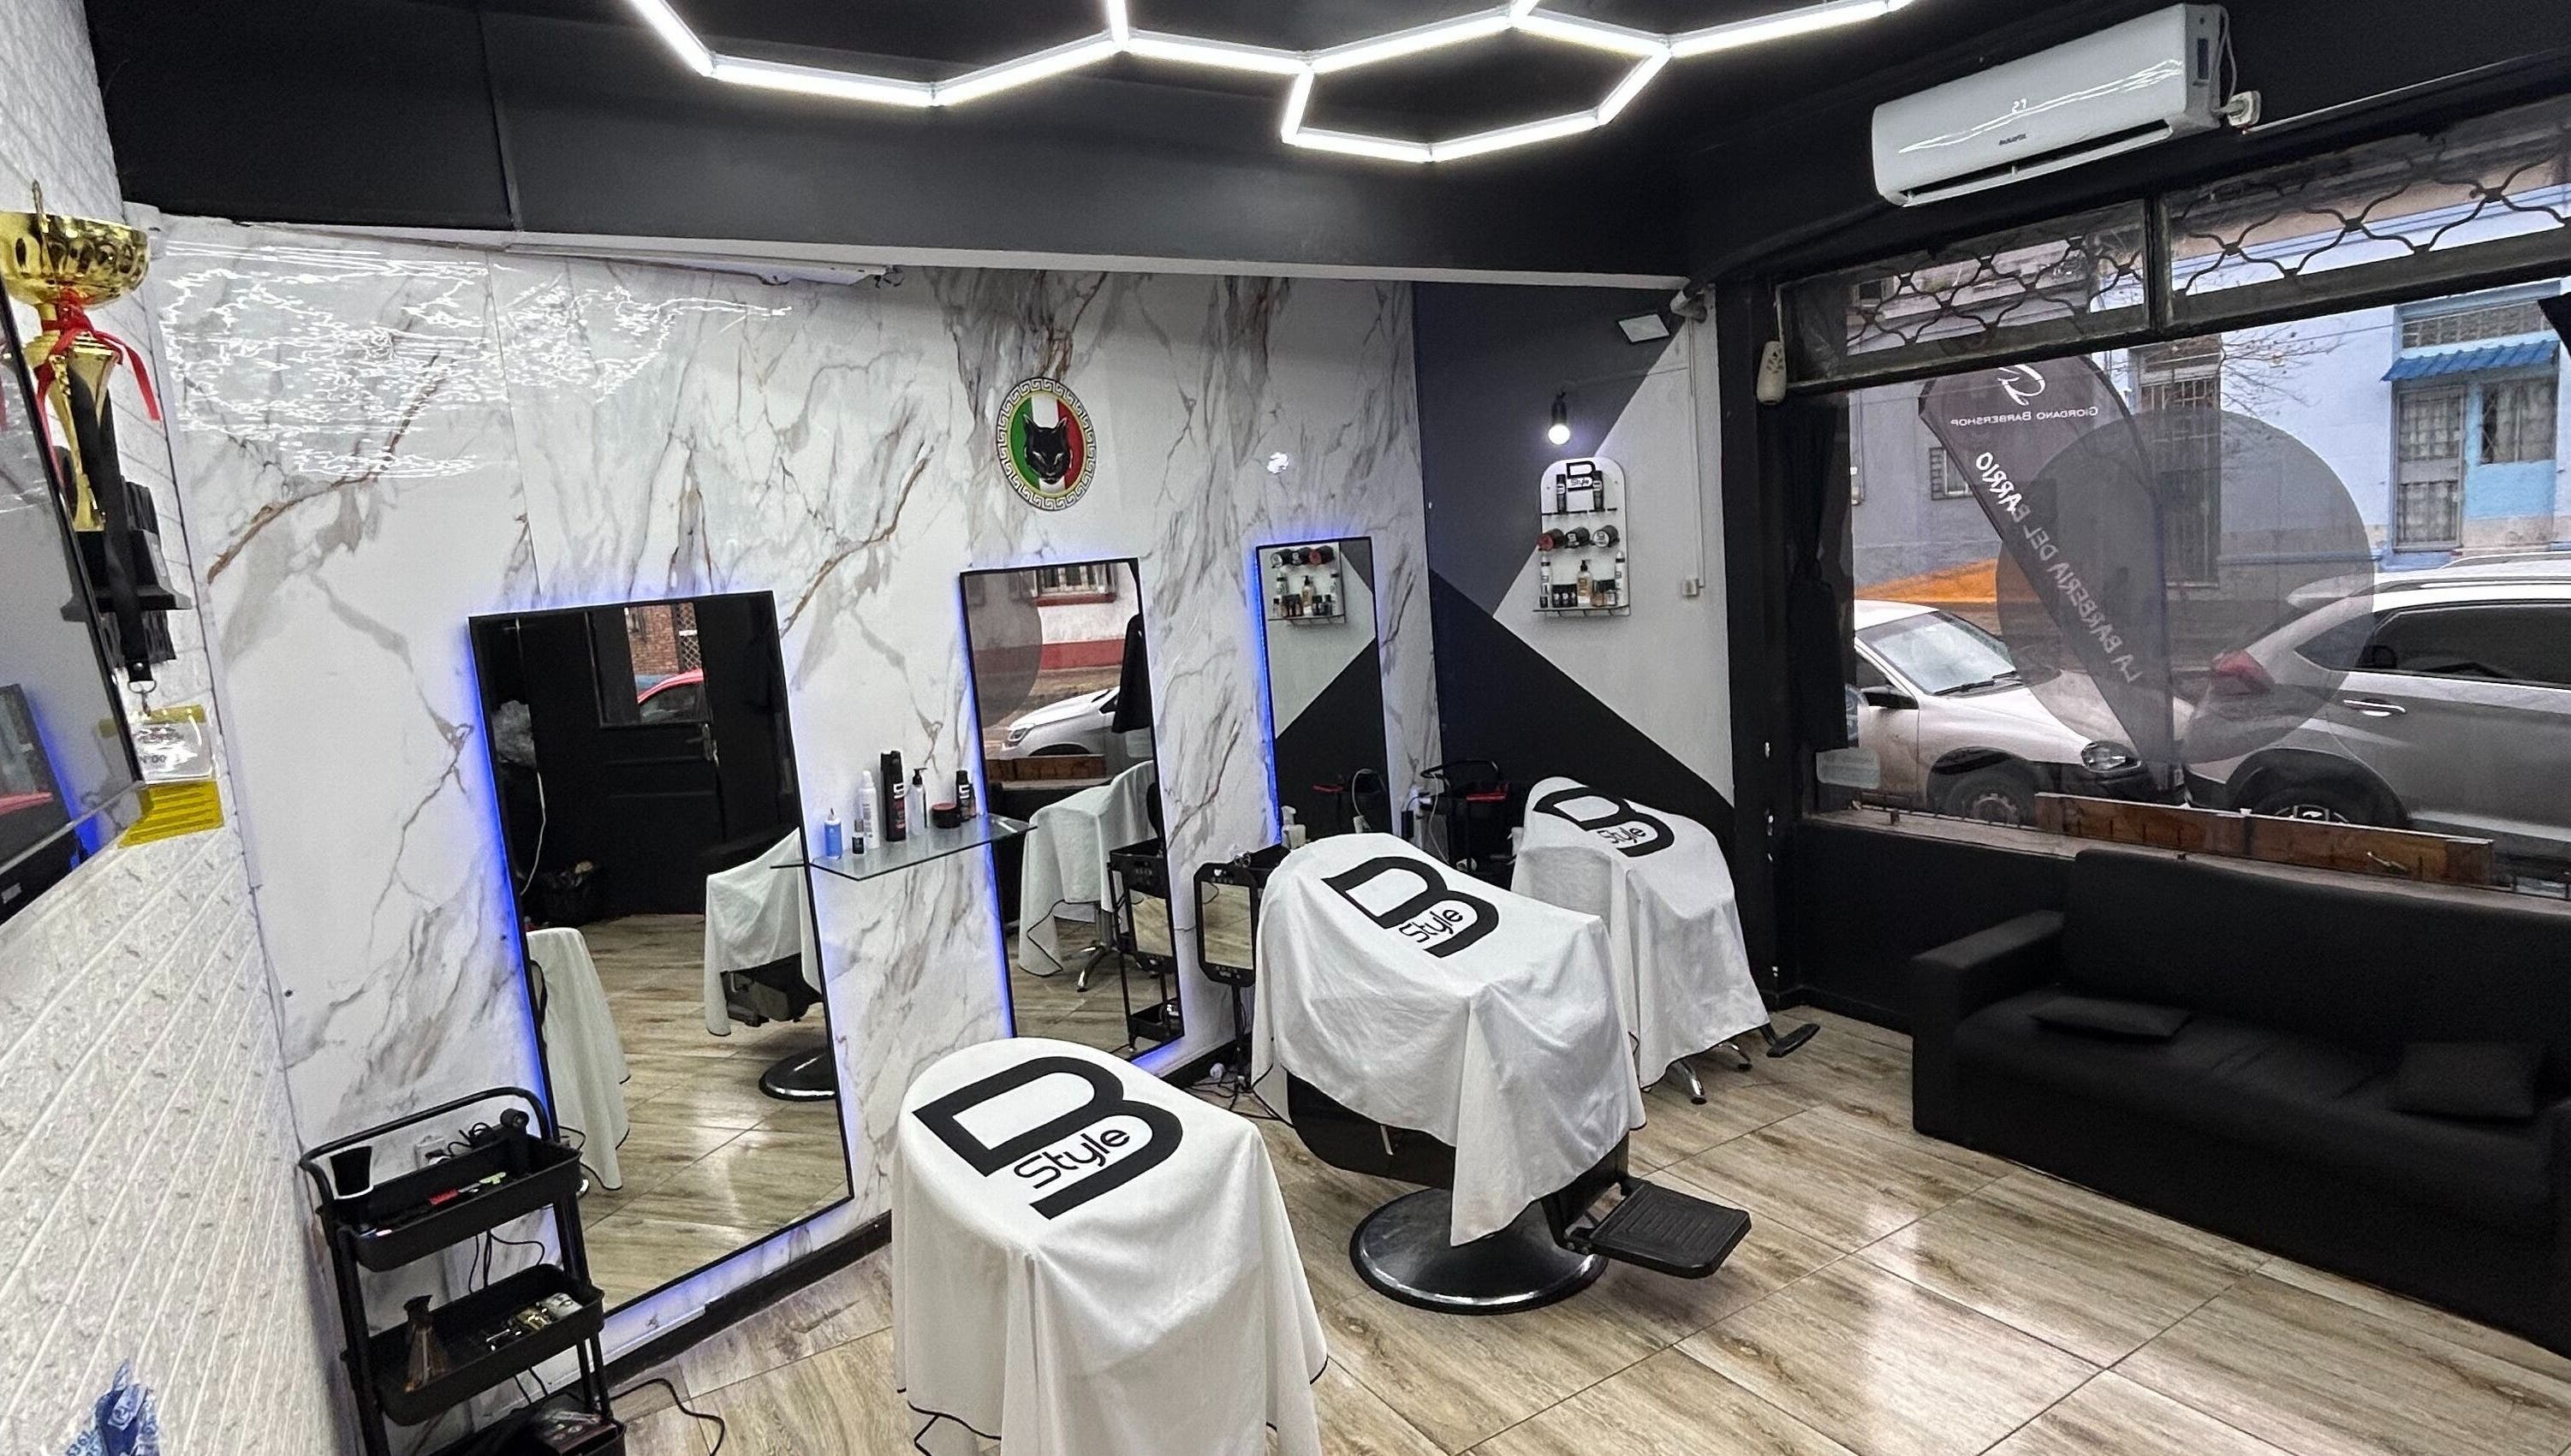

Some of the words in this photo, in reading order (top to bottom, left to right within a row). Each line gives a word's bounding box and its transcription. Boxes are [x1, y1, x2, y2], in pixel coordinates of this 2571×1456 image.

[1597, 827, 1646, 844] Style
[1399, 909, 1463, 942] Style
[1014, 1129, 1130, 1189] Style
